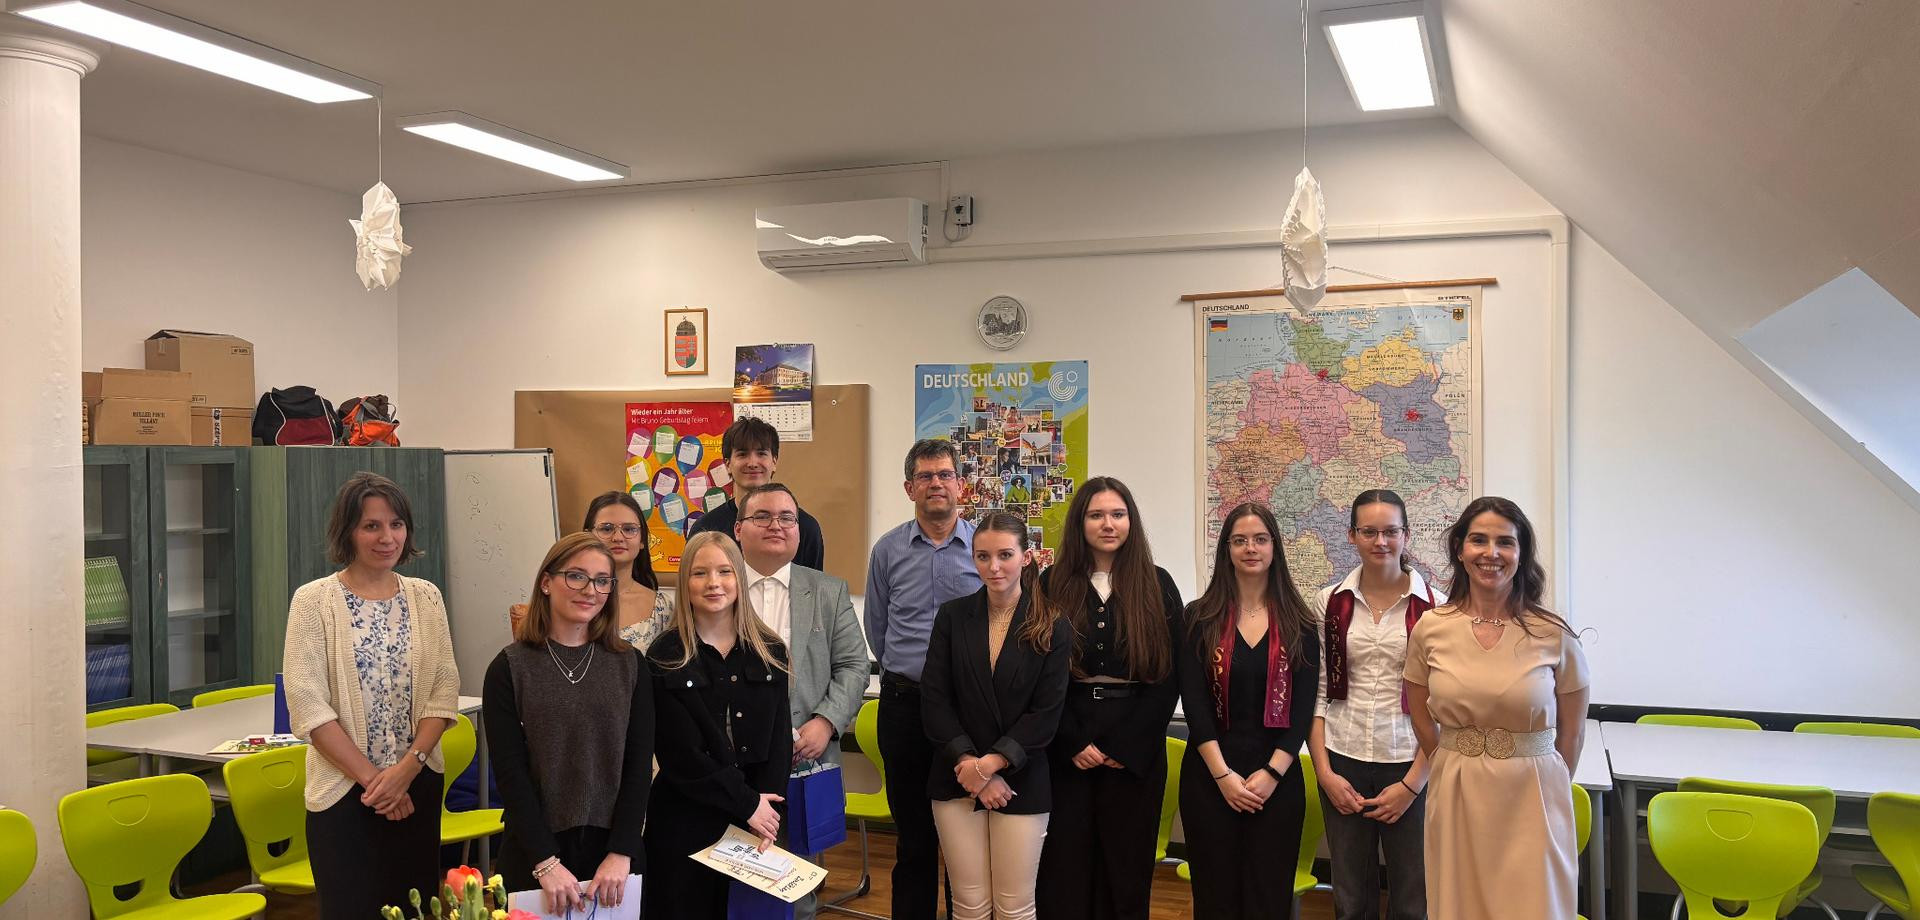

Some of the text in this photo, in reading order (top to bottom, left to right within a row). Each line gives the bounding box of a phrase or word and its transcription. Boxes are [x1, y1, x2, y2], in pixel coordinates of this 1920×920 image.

[1202, 303, 1249, 312] DEUTSCHLAND
[923, 371, 1029, 389] DEUTSCHLAND
[630, 408, 652, 416] Wieder
[659, 416, 691, 425] Geburtstag
[691, 415, 709, 423] feiern
